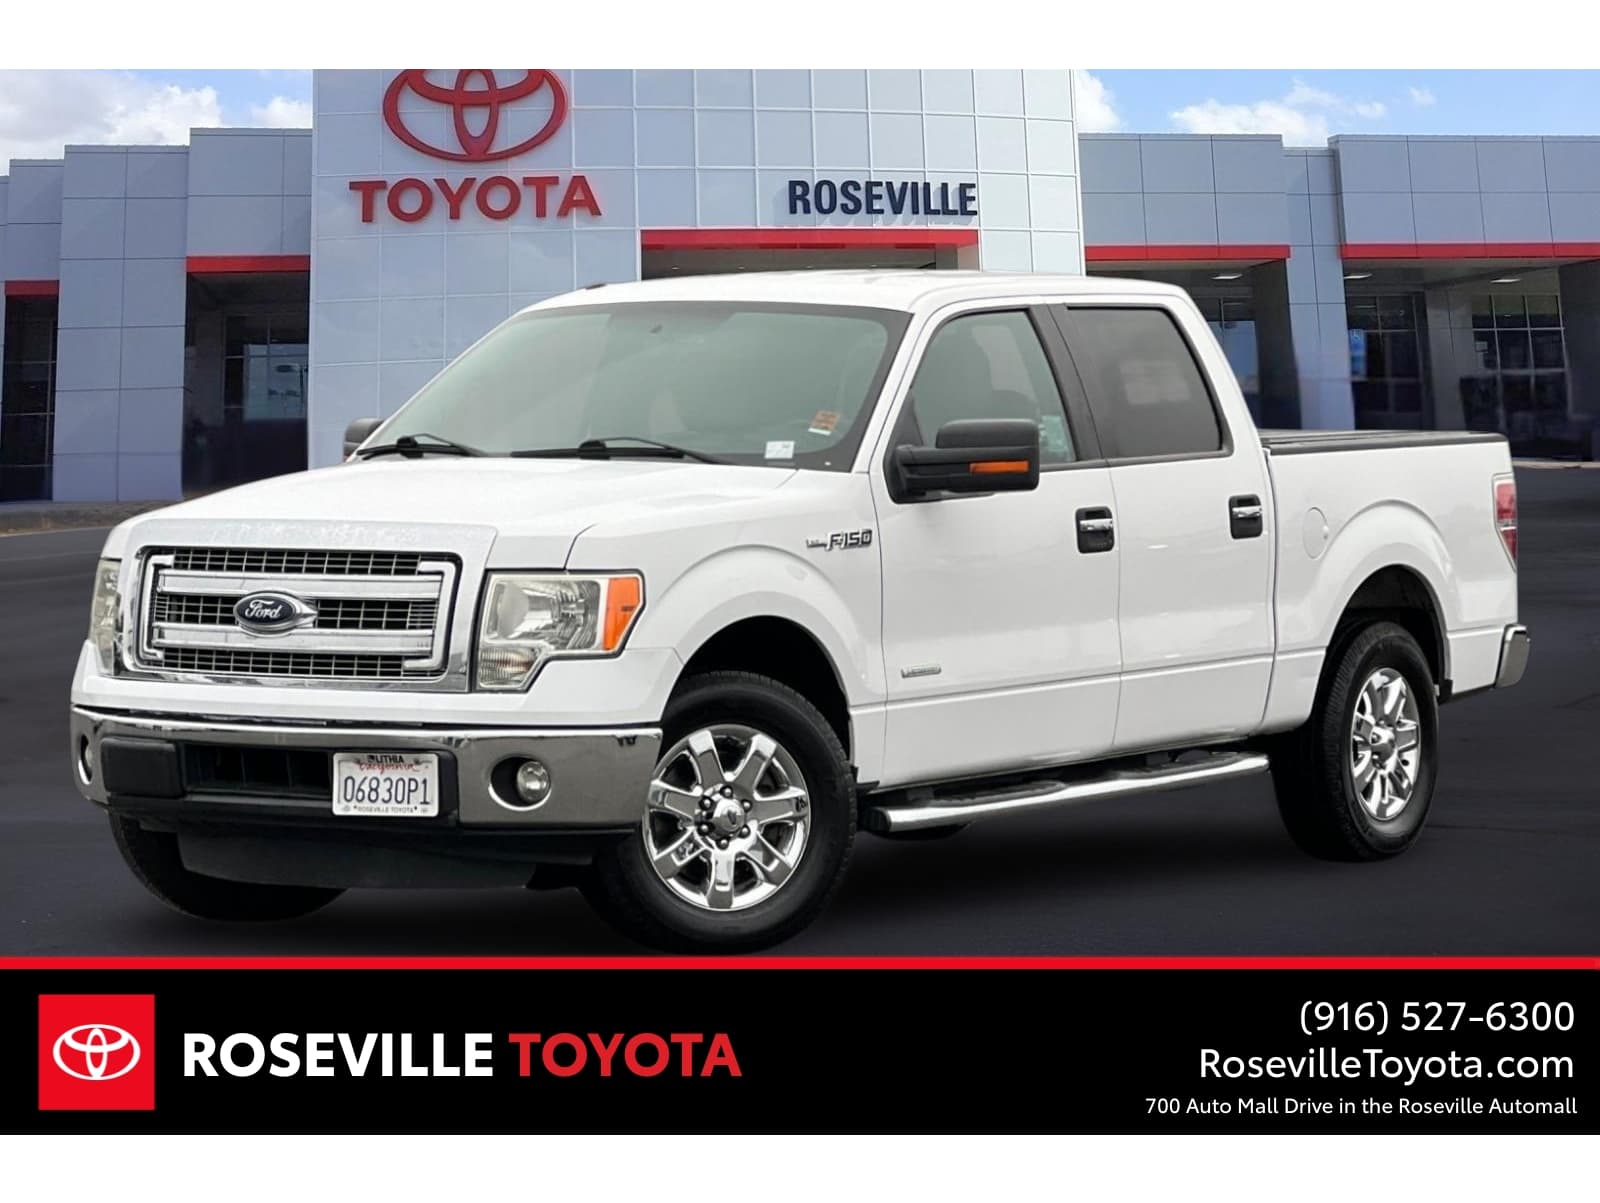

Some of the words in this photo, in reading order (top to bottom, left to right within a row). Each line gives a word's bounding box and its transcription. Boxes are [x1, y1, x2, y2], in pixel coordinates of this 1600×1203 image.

[349, 175, 602, 223] TOYOTA
[788, 179, 978, 216] ROSEVILLE
[824, 528, 872, 552] F-150
[244, 599, 283, 619] Ford
[343, 776, 430, 805] 06830P1
